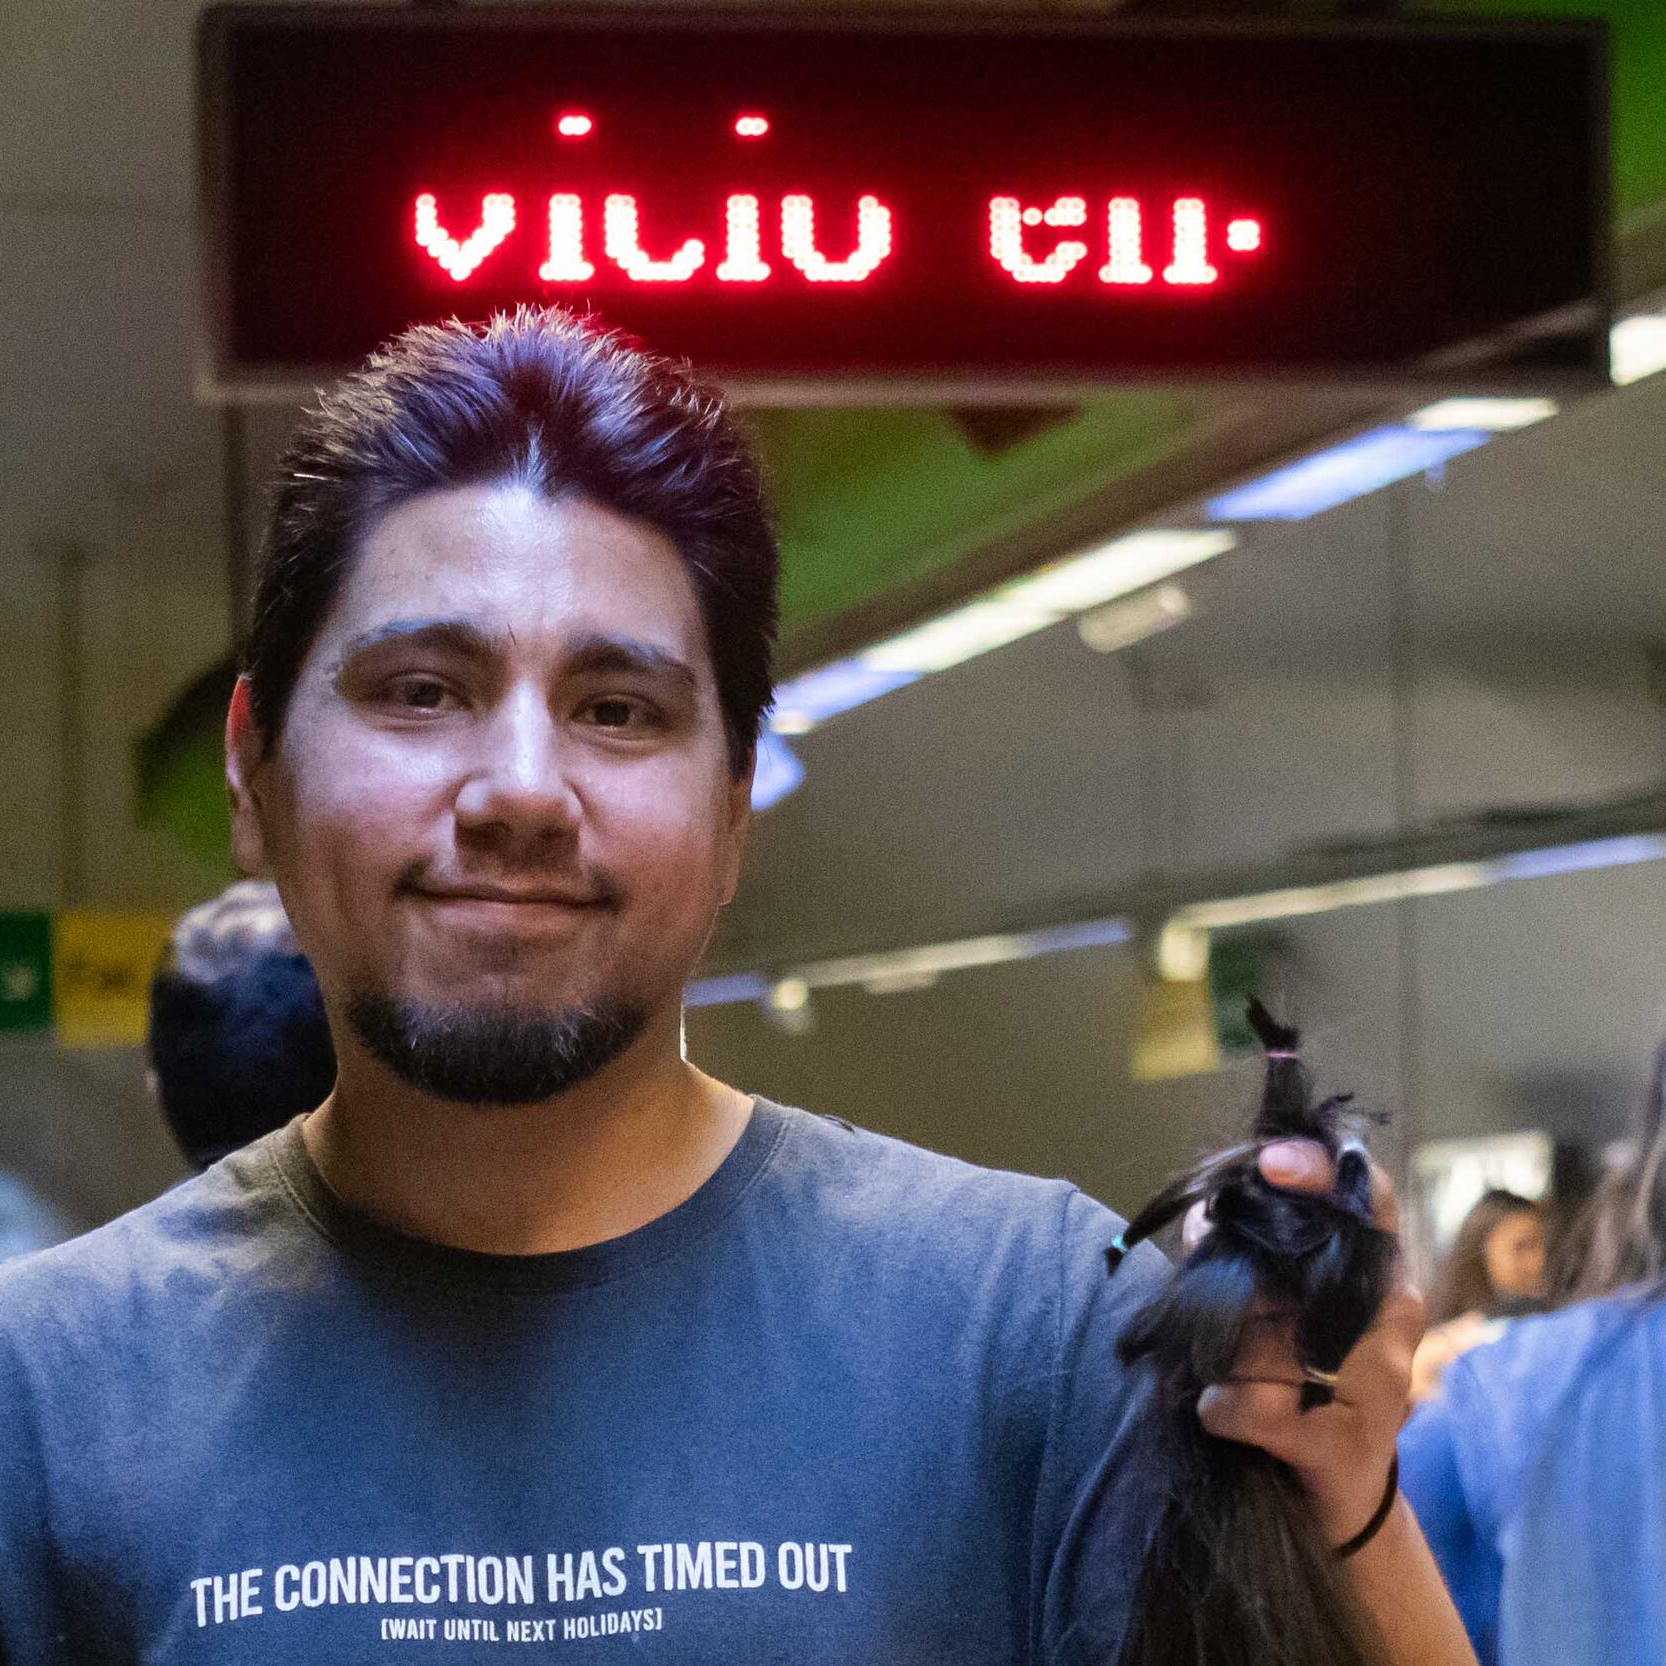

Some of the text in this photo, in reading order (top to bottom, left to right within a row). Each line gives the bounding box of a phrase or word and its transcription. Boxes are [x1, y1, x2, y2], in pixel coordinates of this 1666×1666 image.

[189, 1540, 853, 1628] THE CONNECTION HAS TIMED OUT
[443, 1618, 500, 1642] UNTIL
[506, 1619, 556, 1643] NEXT
